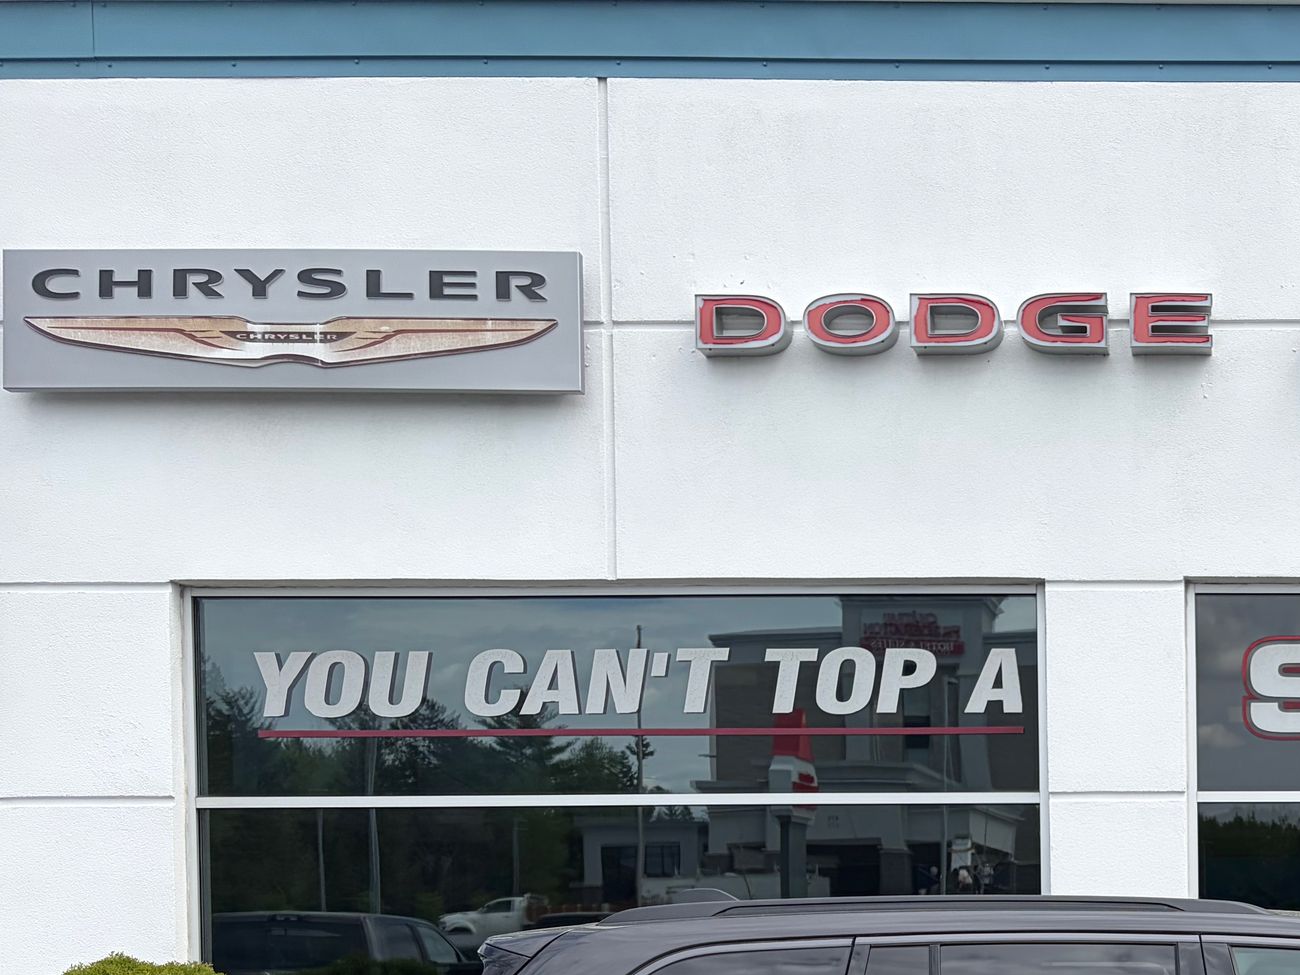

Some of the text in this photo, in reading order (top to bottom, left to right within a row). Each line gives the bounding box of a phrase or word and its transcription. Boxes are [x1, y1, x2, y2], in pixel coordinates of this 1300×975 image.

[31, 267, 549, 302] CHRYSLER
[236, 333, 337, 341] CHRYSLER
[695, 292, 1213, 356] DODGE
[253, 647, 1023, 719] YOU CAN'T TOP A
